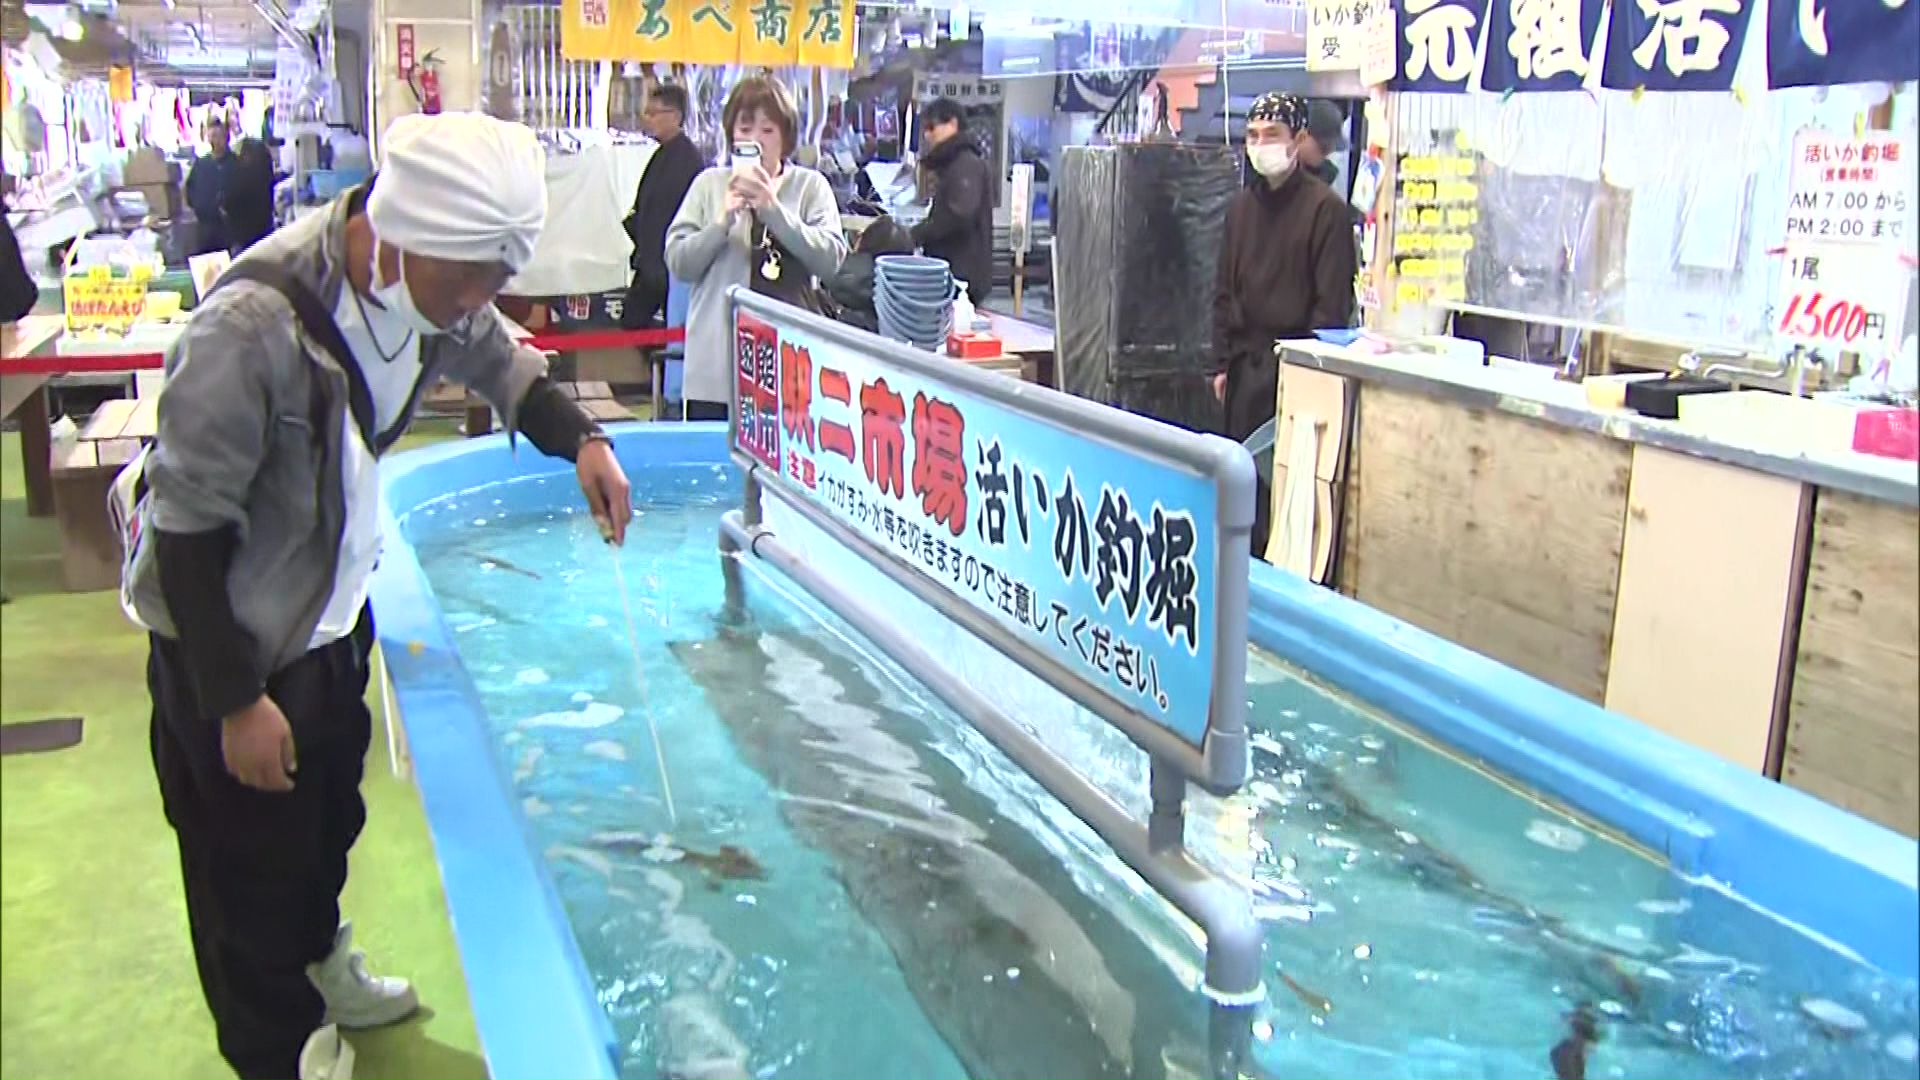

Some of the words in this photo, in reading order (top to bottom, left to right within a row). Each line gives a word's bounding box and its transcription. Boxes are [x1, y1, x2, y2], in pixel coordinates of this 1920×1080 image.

[1805, 143, 1900, 163] 活いか釣堀
[1790, 191, 1818, 209] AM
[1874, 191, 1906, 211] から
[1787, 218, 1814, 235] PM
[1819, 218, 1864, 236] 2:00
[1871, 220, 1903, 238] まで
[787, 449, 817, 491] 注意
[975, 438, 1197, 651] 活いか釣堀
